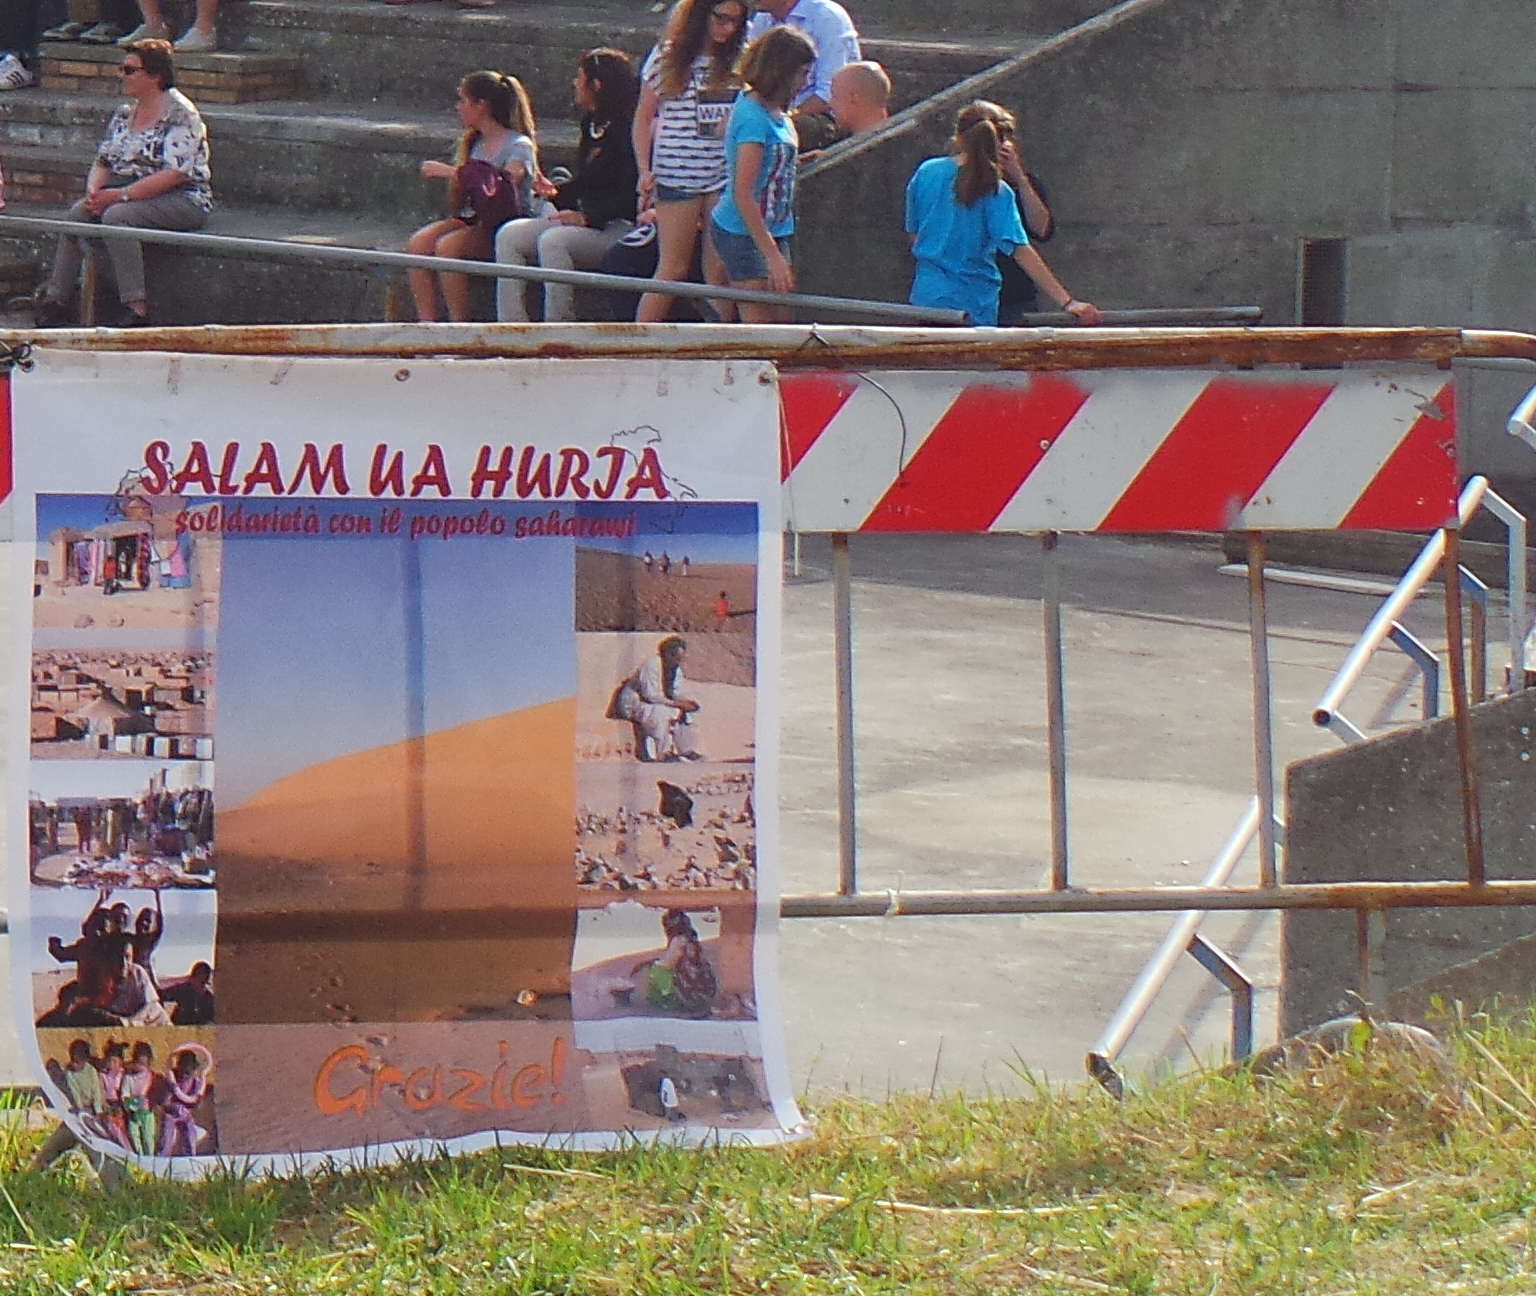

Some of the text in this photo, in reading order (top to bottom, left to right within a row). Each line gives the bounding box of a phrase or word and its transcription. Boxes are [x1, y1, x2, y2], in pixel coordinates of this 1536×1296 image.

[141, 439, 351, 496] SALAM
[470, 444, 670, 500] HURJA
[176, 503, 636, 542] solidarietà con il popolo saharawi
[314, 1036, 567, 1118] Grazie!
